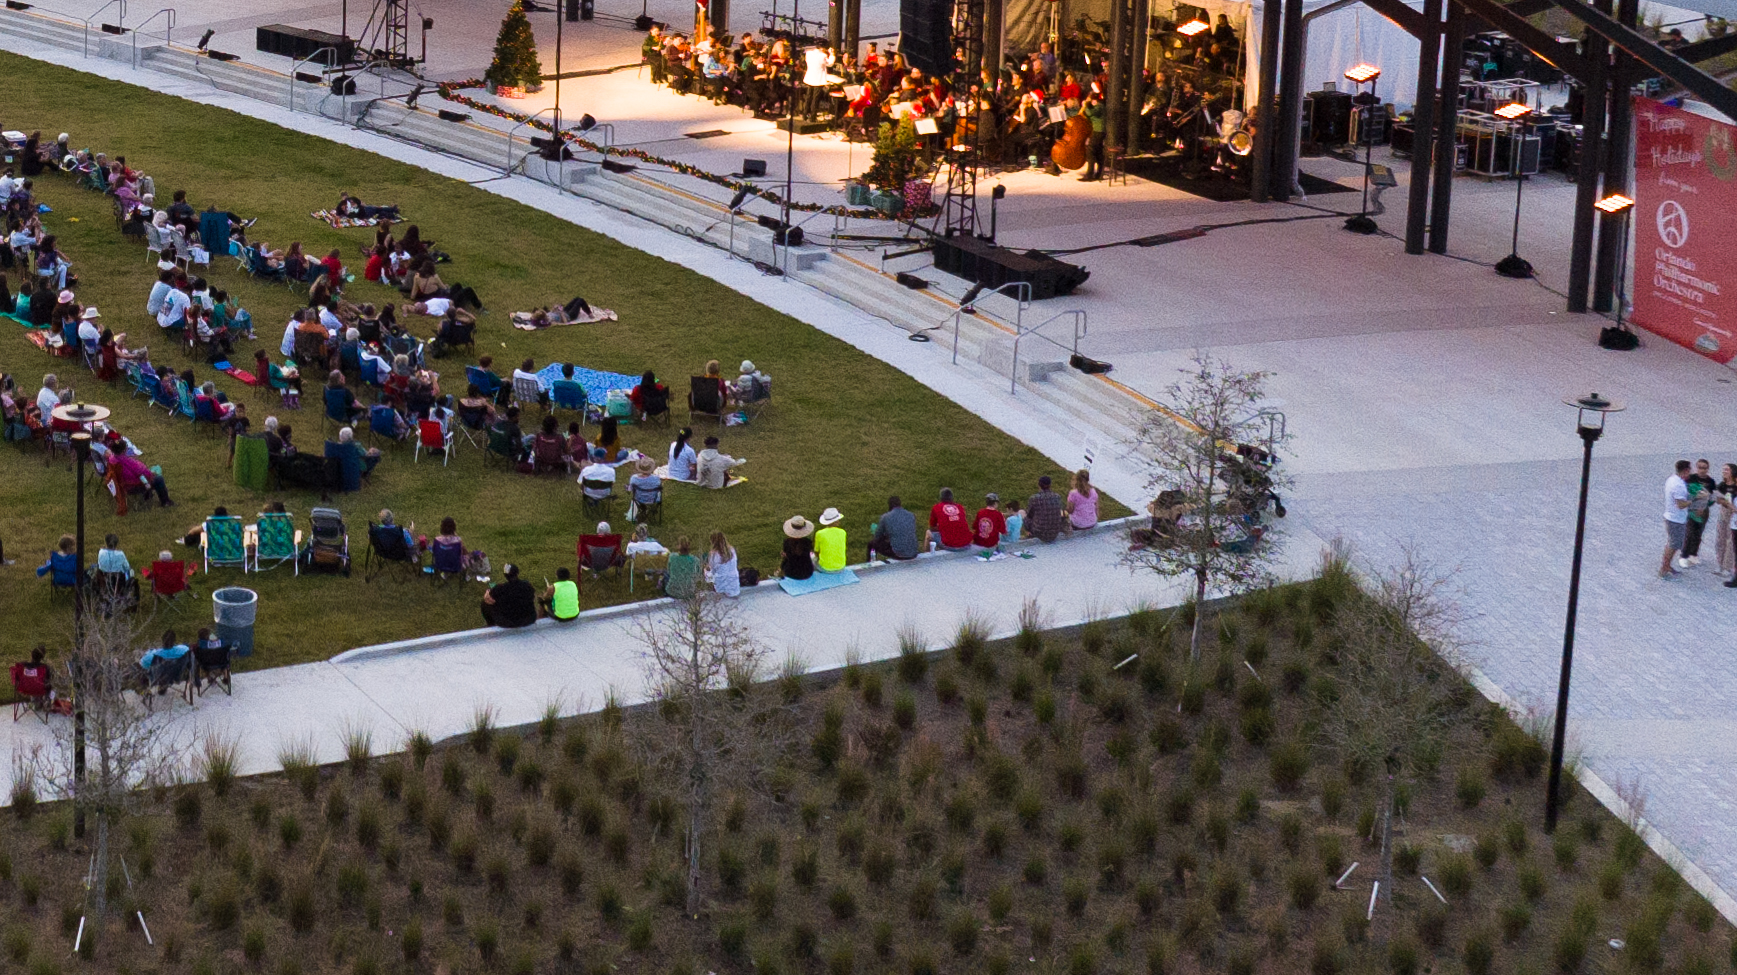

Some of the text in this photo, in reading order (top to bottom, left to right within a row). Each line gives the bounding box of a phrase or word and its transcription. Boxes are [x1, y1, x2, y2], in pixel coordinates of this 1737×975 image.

[1655, 247, 1696, 271] Orlando
[1653, 274, 1703, 303] Orchestra
[1655, 260, 1720, 296] Philharmonic
